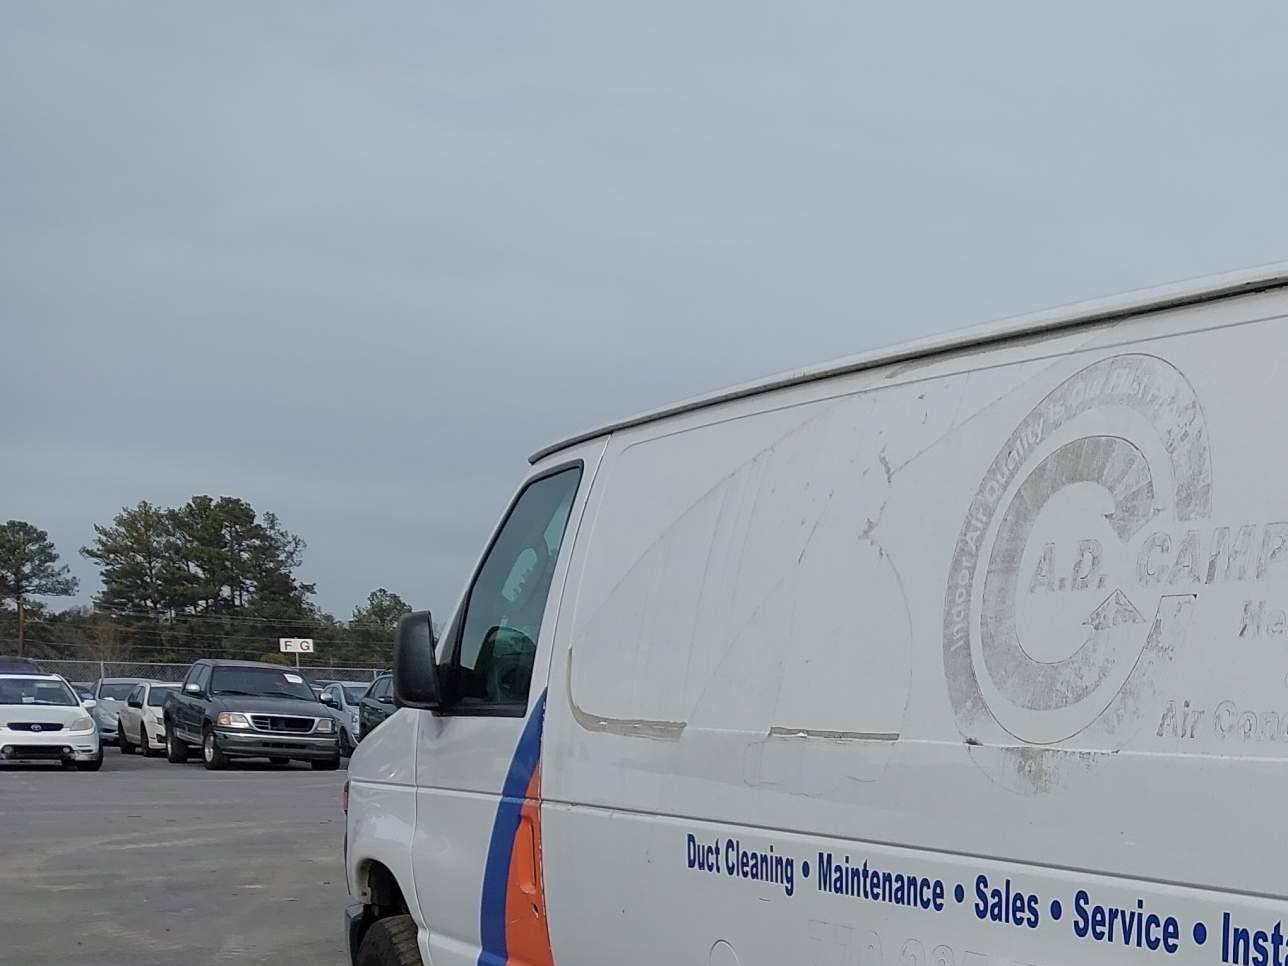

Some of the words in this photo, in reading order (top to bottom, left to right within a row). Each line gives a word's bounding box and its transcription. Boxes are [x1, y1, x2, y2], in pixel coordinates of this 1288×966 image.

[284, 640, 293, 650] F
[299, 640, 311, 651] G
[1155, 699, 1206, 740] Air
[686, 833, 721, 873] Duct
[724, 838, 796, 897] Cleaning
[817, 851, 945, 912] Maintenance
[974, 874, 1041, 929] Sales
[1073, 889, 1180, 954] Service
